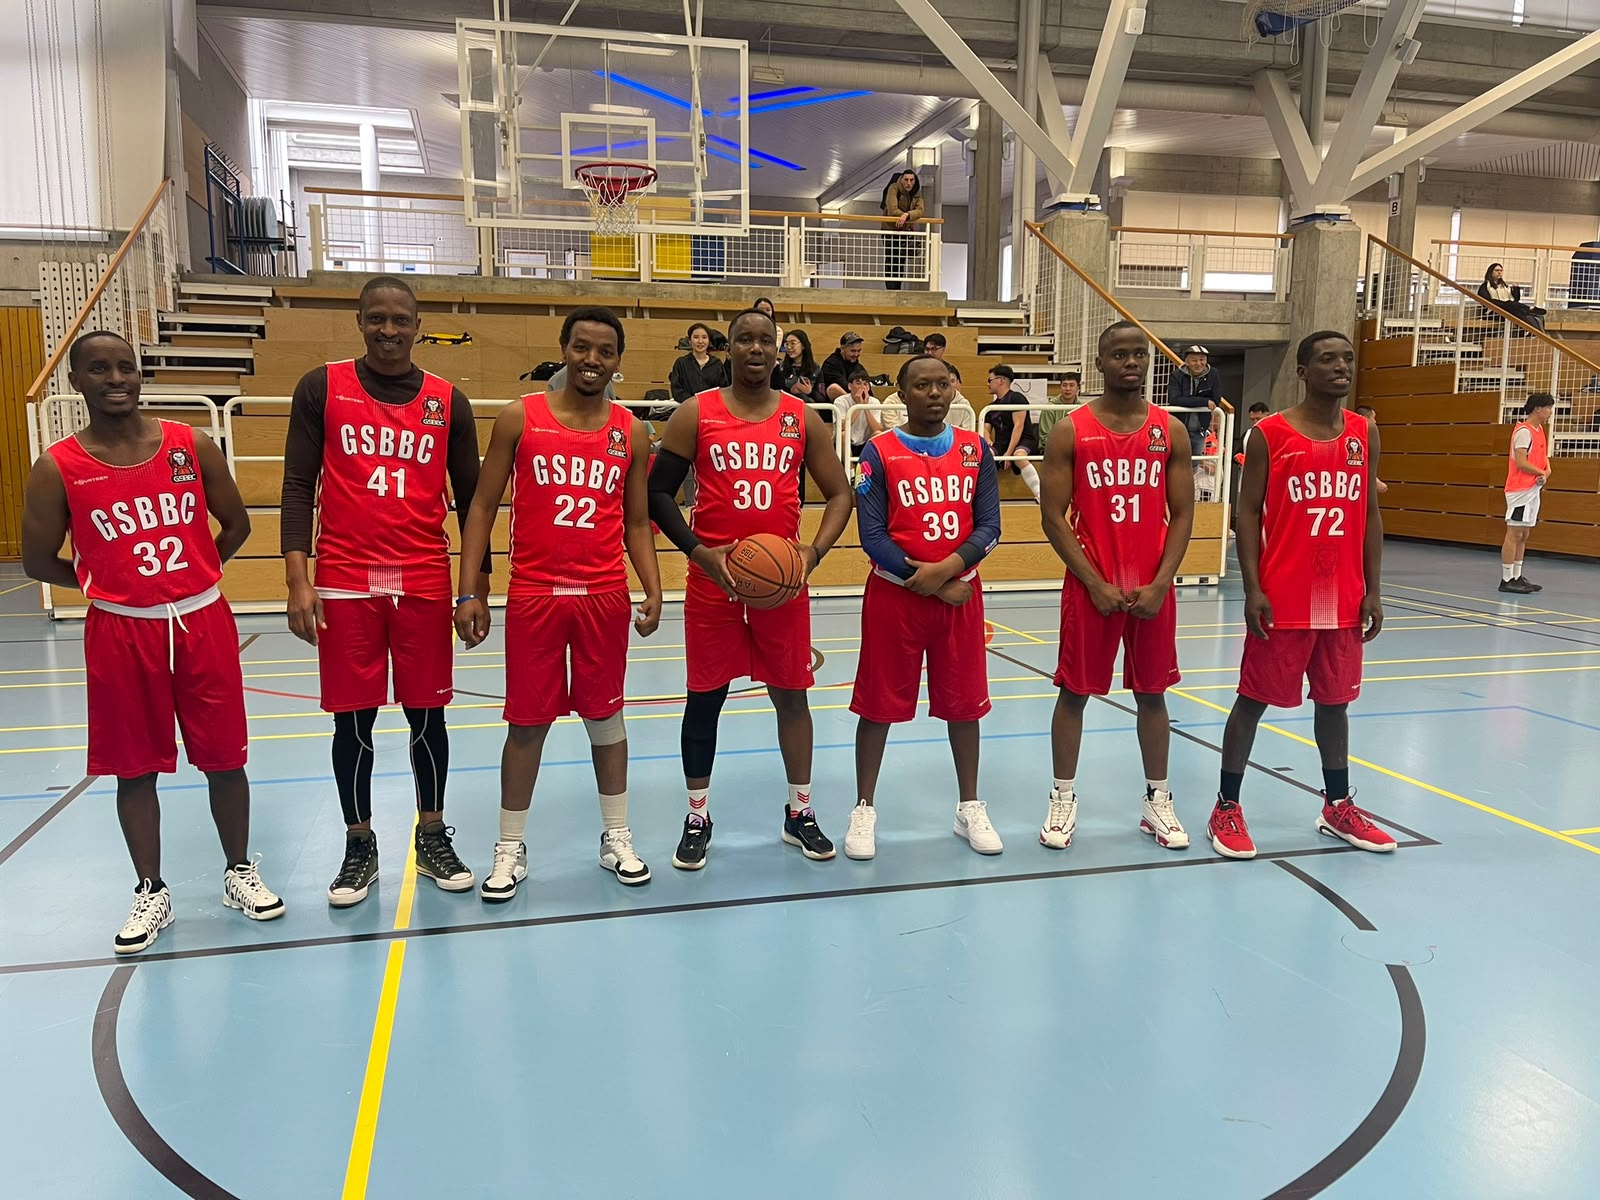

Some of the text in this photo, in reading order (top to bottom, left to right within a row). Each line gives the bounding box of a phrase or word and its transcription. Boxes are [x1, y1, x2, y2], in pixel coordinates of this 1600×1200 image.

[1392, 202, 1398, 212] B
[340, 423, 436, 464] GSBBC
[709, 441, 795, 475] GSBBC
[173, 473, 197, 483] GSBBC
[366, 465, 407, 499] 41
[532, 454, 621, 494] GSBBC
[1086, 458, 1162, 489] GSBBC
[1287, 471, 1361, 503] GSBBC
[733, 479, 773, 511] 30
[897, 474, 973, 508] GSBBC
[90, 491, 197, 542] GSBBC
[553, 494, 597, 529] 22
[1110, 493, 1140, 523] 31
[1306, 507, 1345, 537] 72
[922, 510, 960, 541] 39
[132, 535, 189, 577] 32
